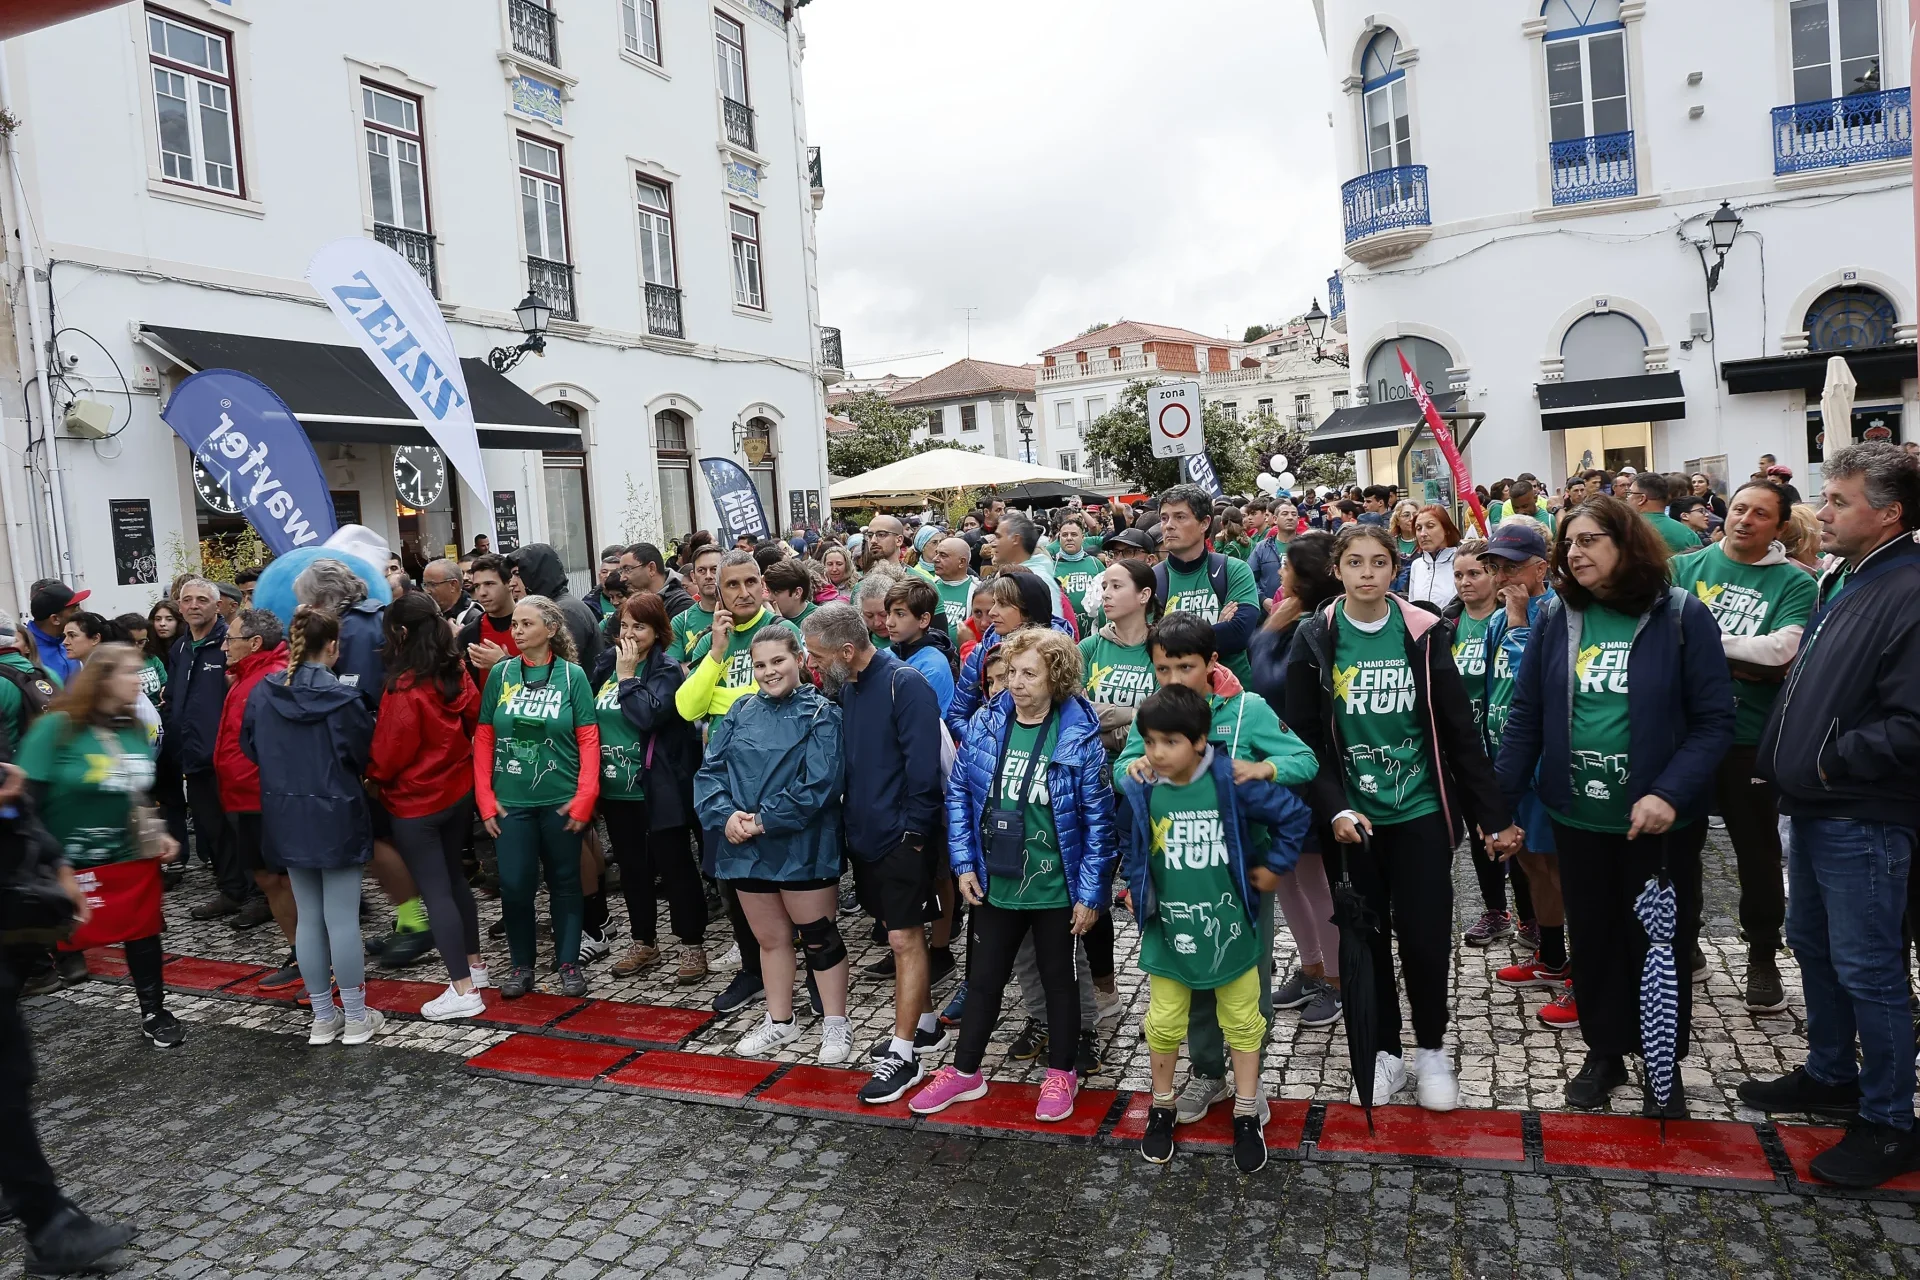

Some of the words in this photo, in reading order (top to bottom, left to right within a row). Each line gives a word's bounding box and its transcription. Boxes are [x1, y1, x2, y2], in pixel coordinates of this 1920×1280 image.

[331, 270, 466, 421] ZEISS
[1160, 389, 1185, 399] zona
[1067, 583, 1088, 594] RU
[1710, 590, 1769, 618] LEIRIA
[1607, 641, 1629, 649] MAIO
[1363, 660, 1384, 668] MAIO
[1384, 658, 1406, 667] 2025
[1454, 658, 1486, 676] RU
[726, 669, 754, 688] RU
[1099, 670, 1154, 690] LEIRIA
[1349, 667, 1415, 690] LEIRIA
[1580, 669, 1629, 693] RU
[512, 687, 562, 704] LEIRIA
[1345, 689, 1416, 715] RUN
[505, 700, 562, 719] RUN
[1011, 750, 1029, 758] MAIO
[1175, 811, 1197, 820] MAIO
[1165, 841, 1229, 870] RUN
